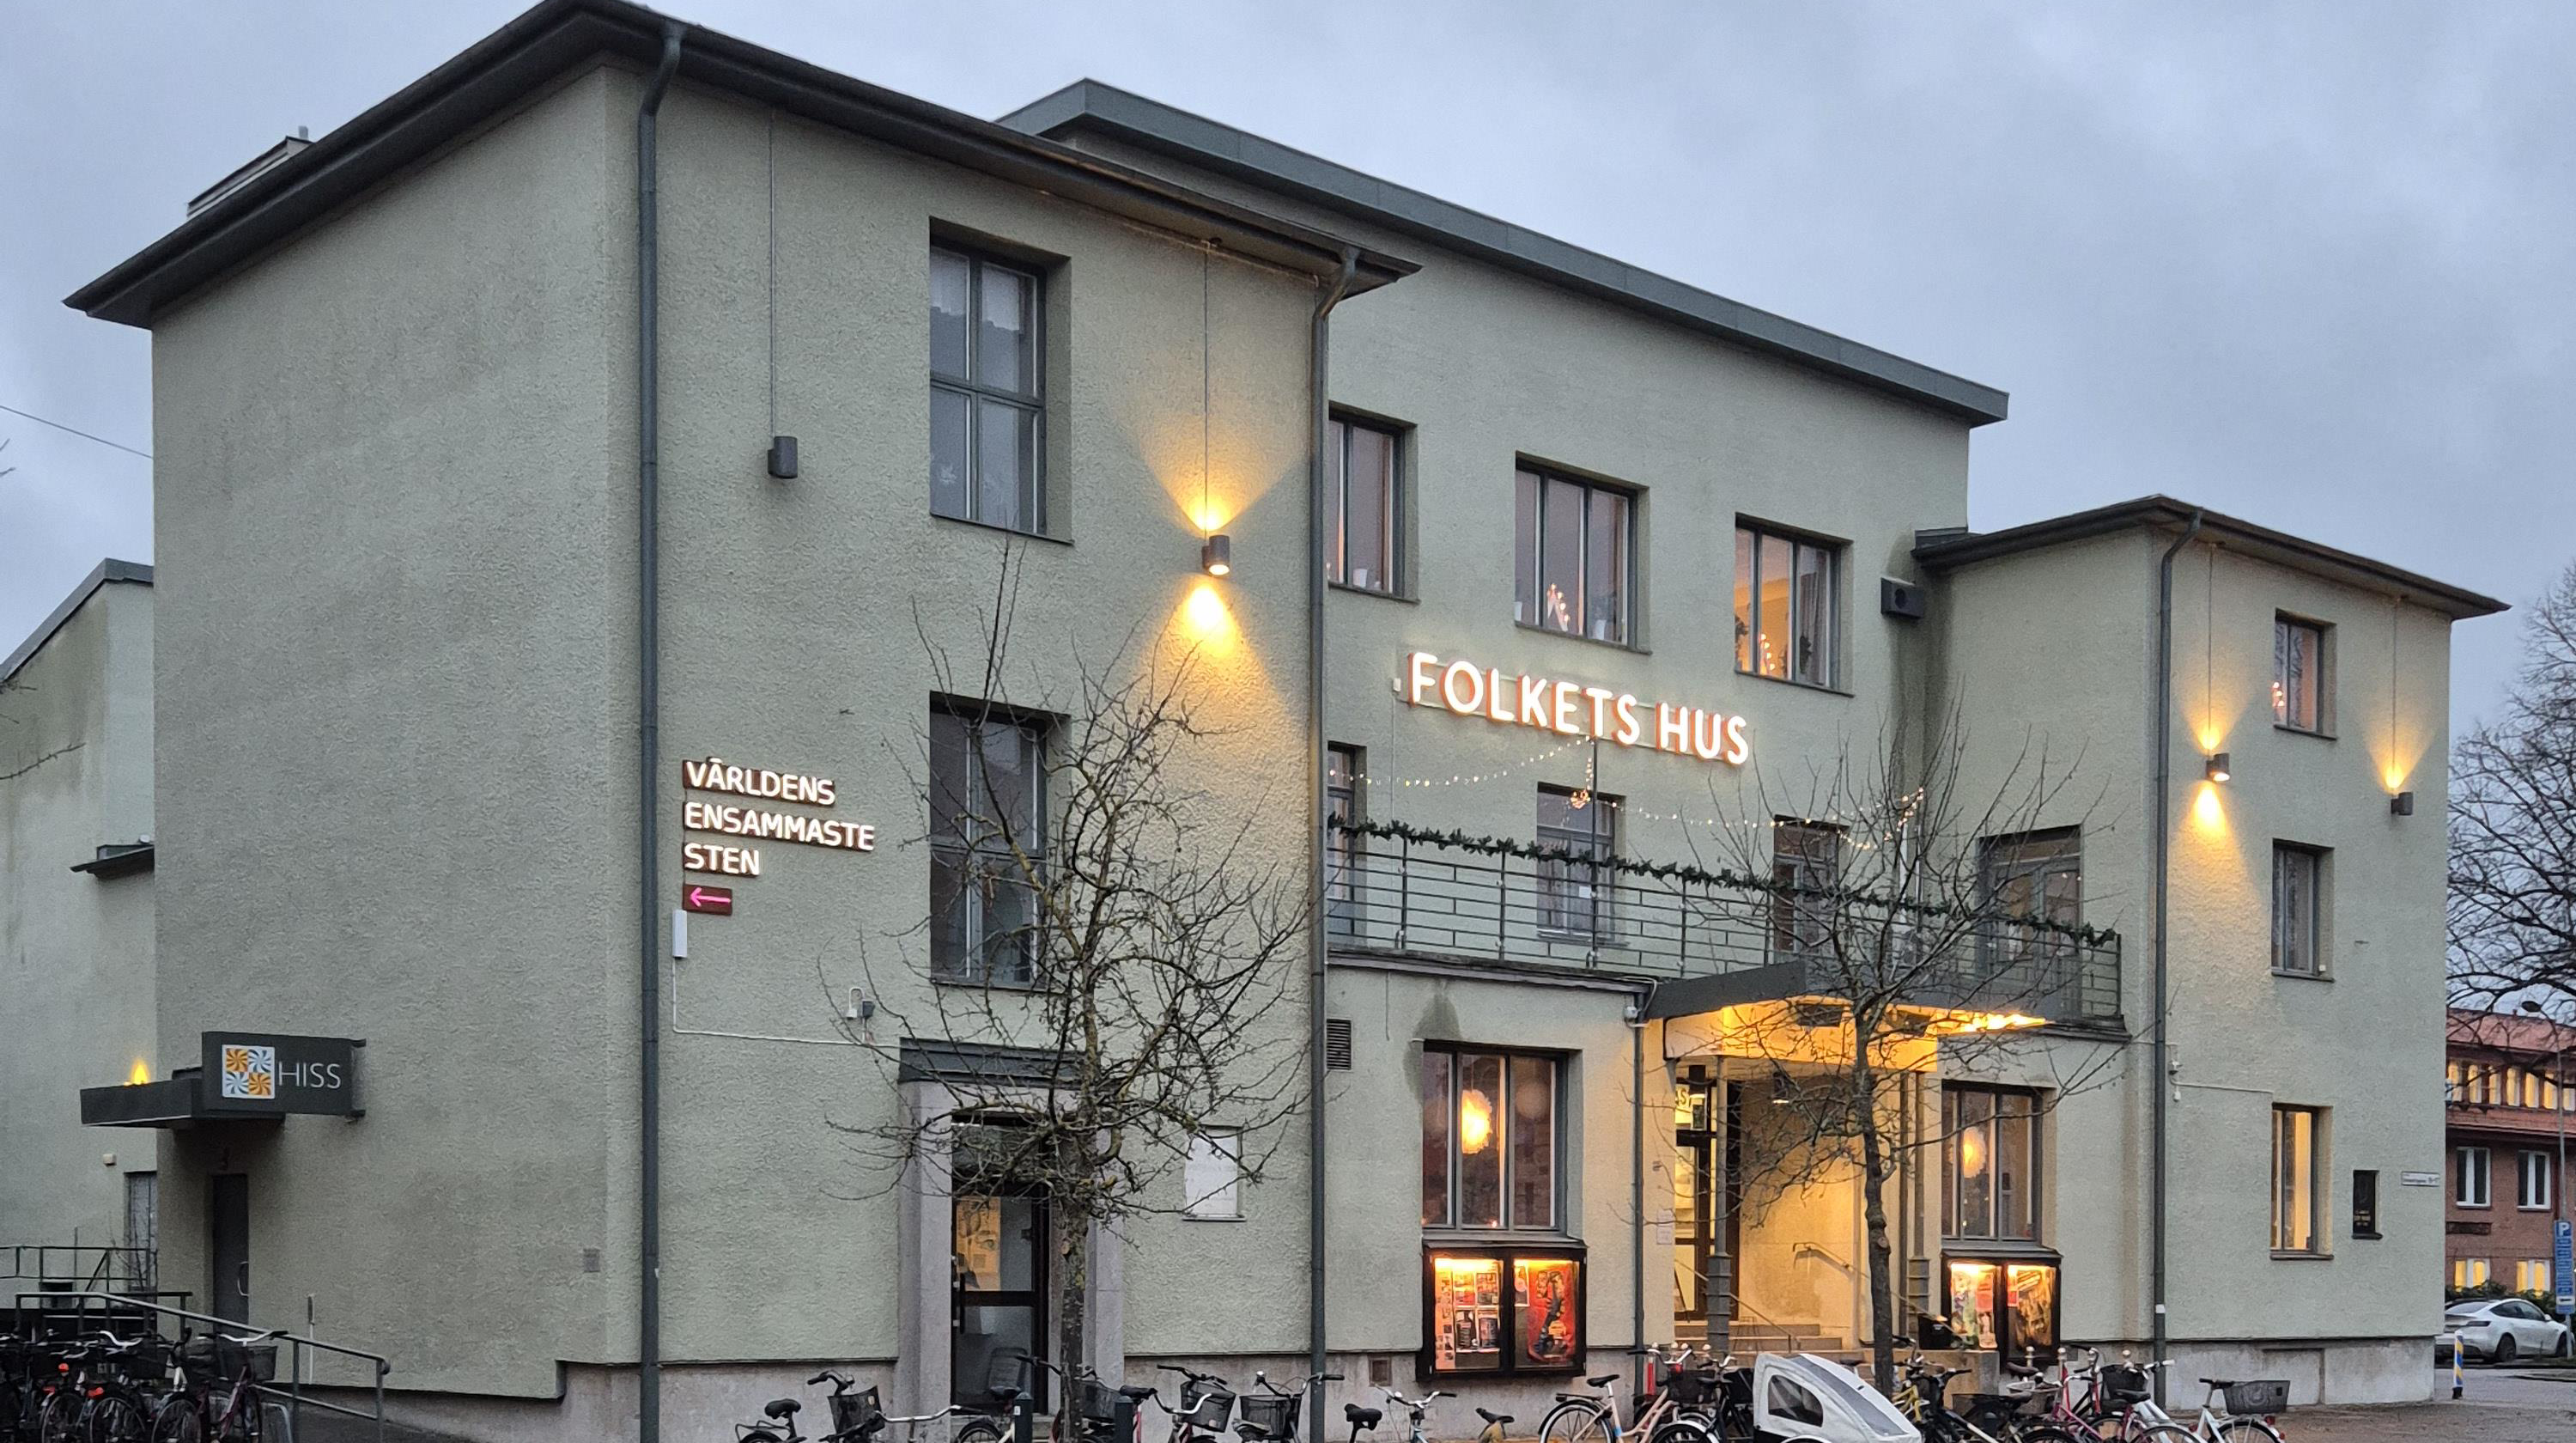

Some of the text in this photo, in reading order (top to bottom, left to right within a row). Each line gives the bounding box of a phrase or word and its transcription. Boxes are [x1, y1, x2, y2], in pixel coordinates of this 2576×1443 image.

[1408, 651, 1749, 765] FOLKETS HUS
[685, 758, 835, 806] VÄRLDENS
[684, 801, 876, 852] ENSAMMASTE
[684, 843, 761, 876] STEN
[278, 1061, 342, 1088] HISS
[2558, 1221, 2570, 1237] P
